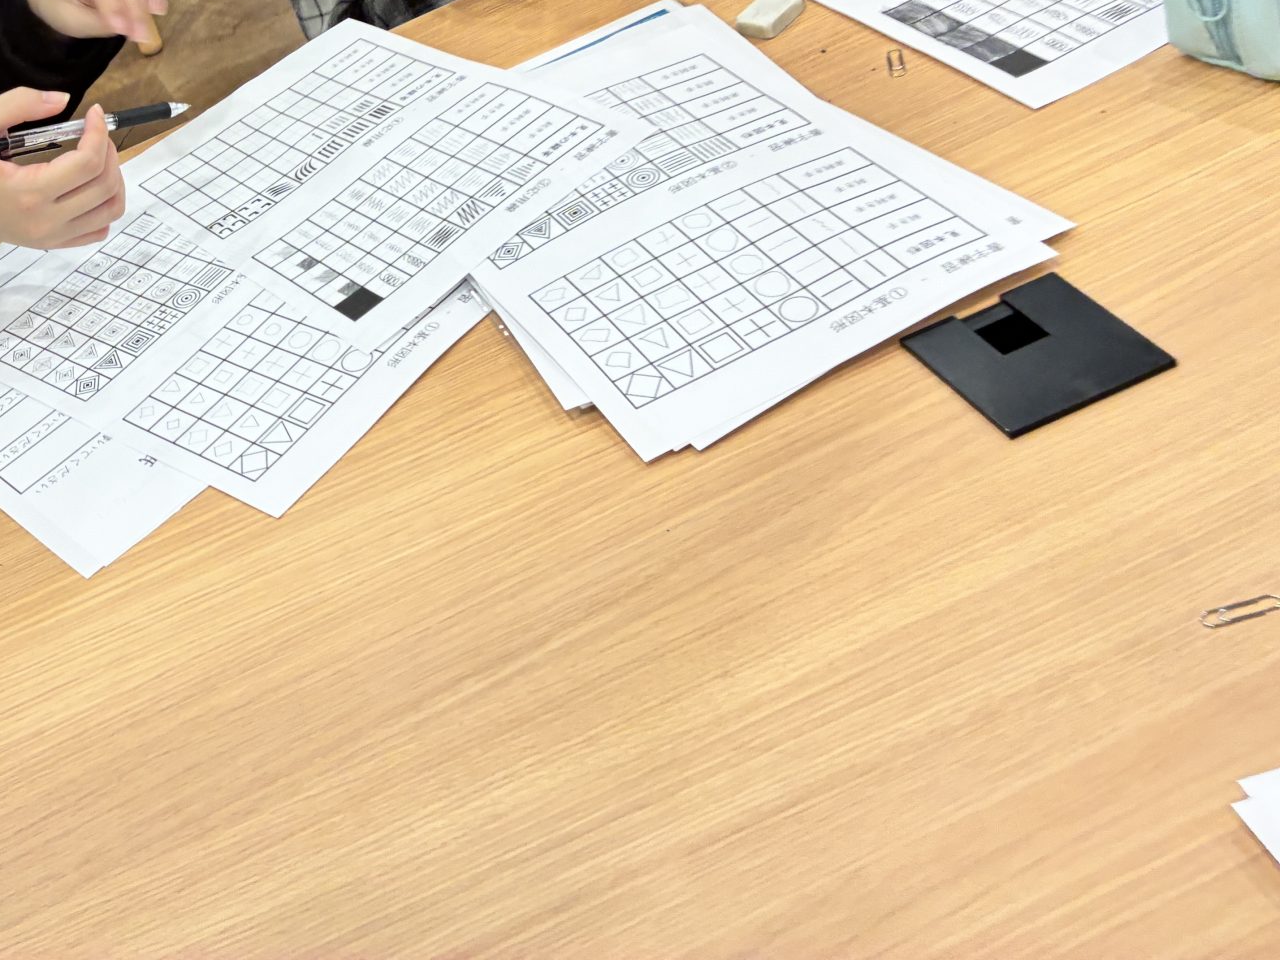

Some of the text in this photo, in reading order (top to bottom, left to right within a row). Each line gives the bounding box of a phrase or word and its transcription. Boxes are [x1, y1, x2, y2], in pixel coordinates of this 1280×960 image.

[906, 230, 961, 255] 見本図形
[829, 242, 1005, 333] 書字練習 ①基本図形
[387, 322, 440, 368] ①基本図形
